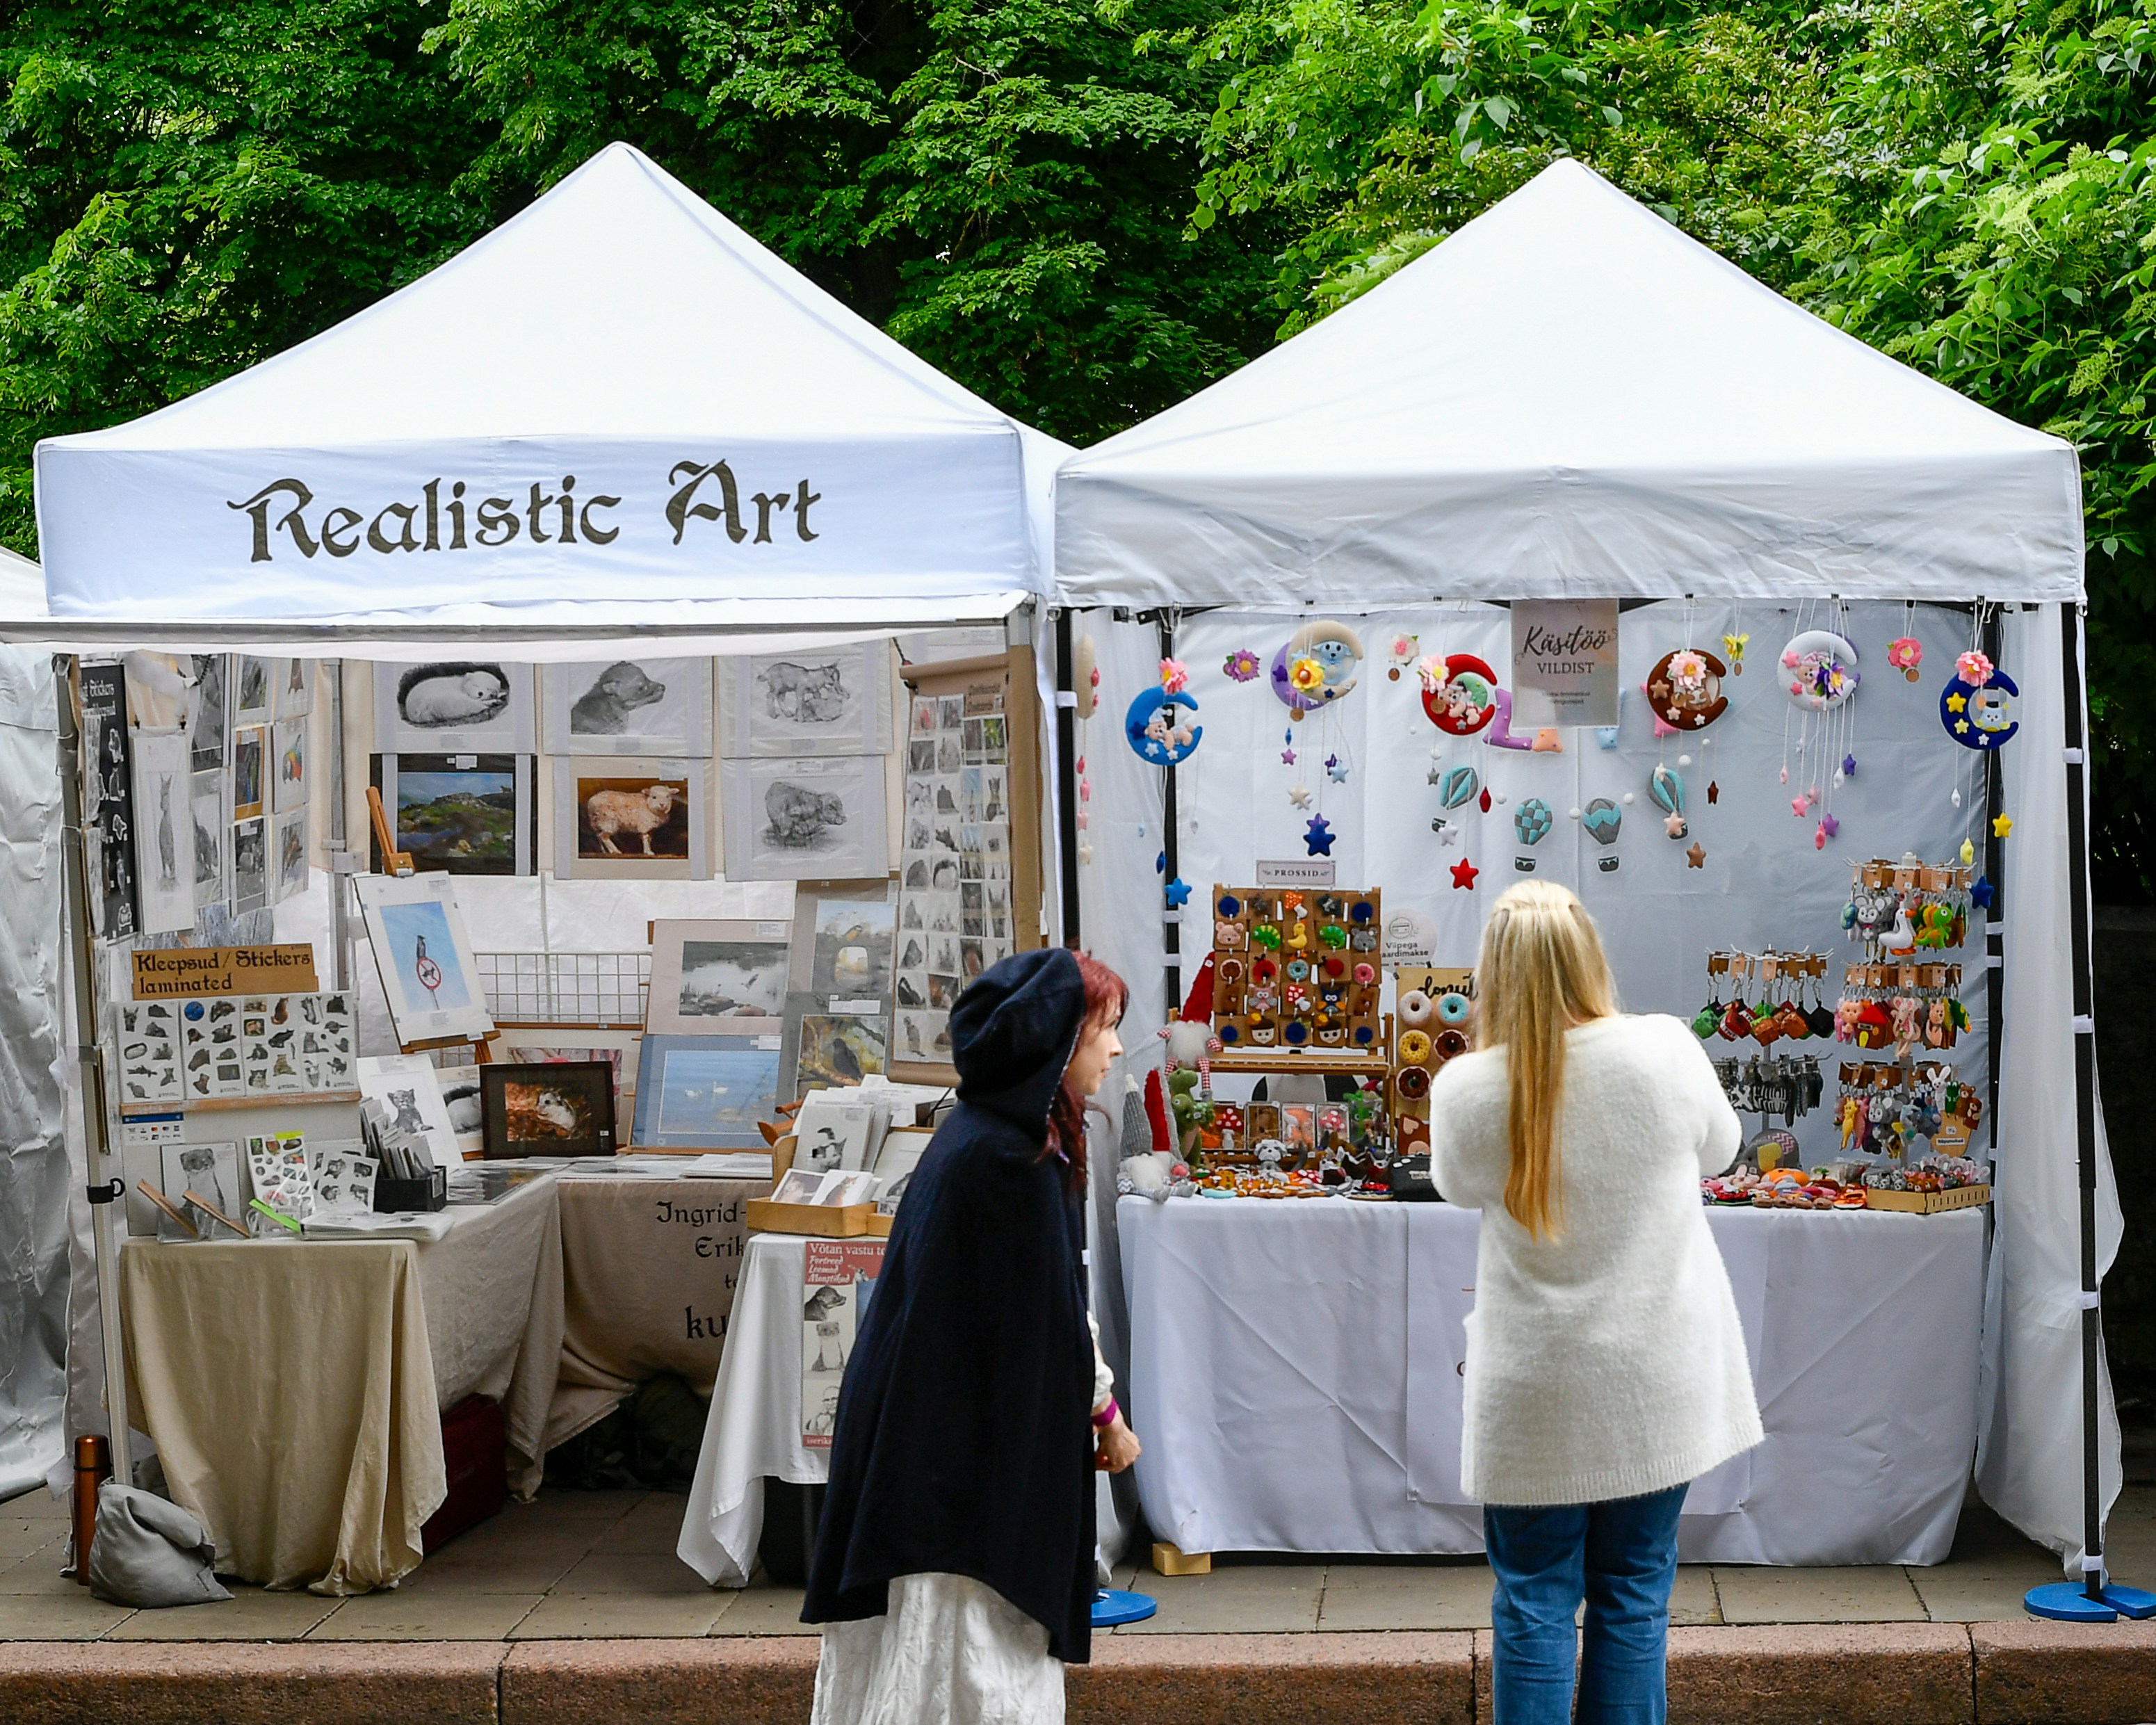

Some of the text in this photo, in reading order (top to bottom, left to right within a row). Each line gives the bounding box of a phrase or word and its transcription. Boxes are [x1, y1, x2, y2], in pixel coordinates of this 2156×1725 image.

[227, 458, 822, 562] Realistic Art
[1523, 625, 1607, 656] Käsitöö
[1537, 662, 1594, 674] VILDIST
[1386, 942, 1418, 953] Viipega
[135, 952, 219, 975] Kleepsud
[236, 950, 311, 968] Stickers
[140, 973, 232, 994] laminated
[656, 1201, 747, 1228] Ingrid-
[810, 1243, 843, 1254] Võtan
[845, 1247, 874, 1256] vastu
